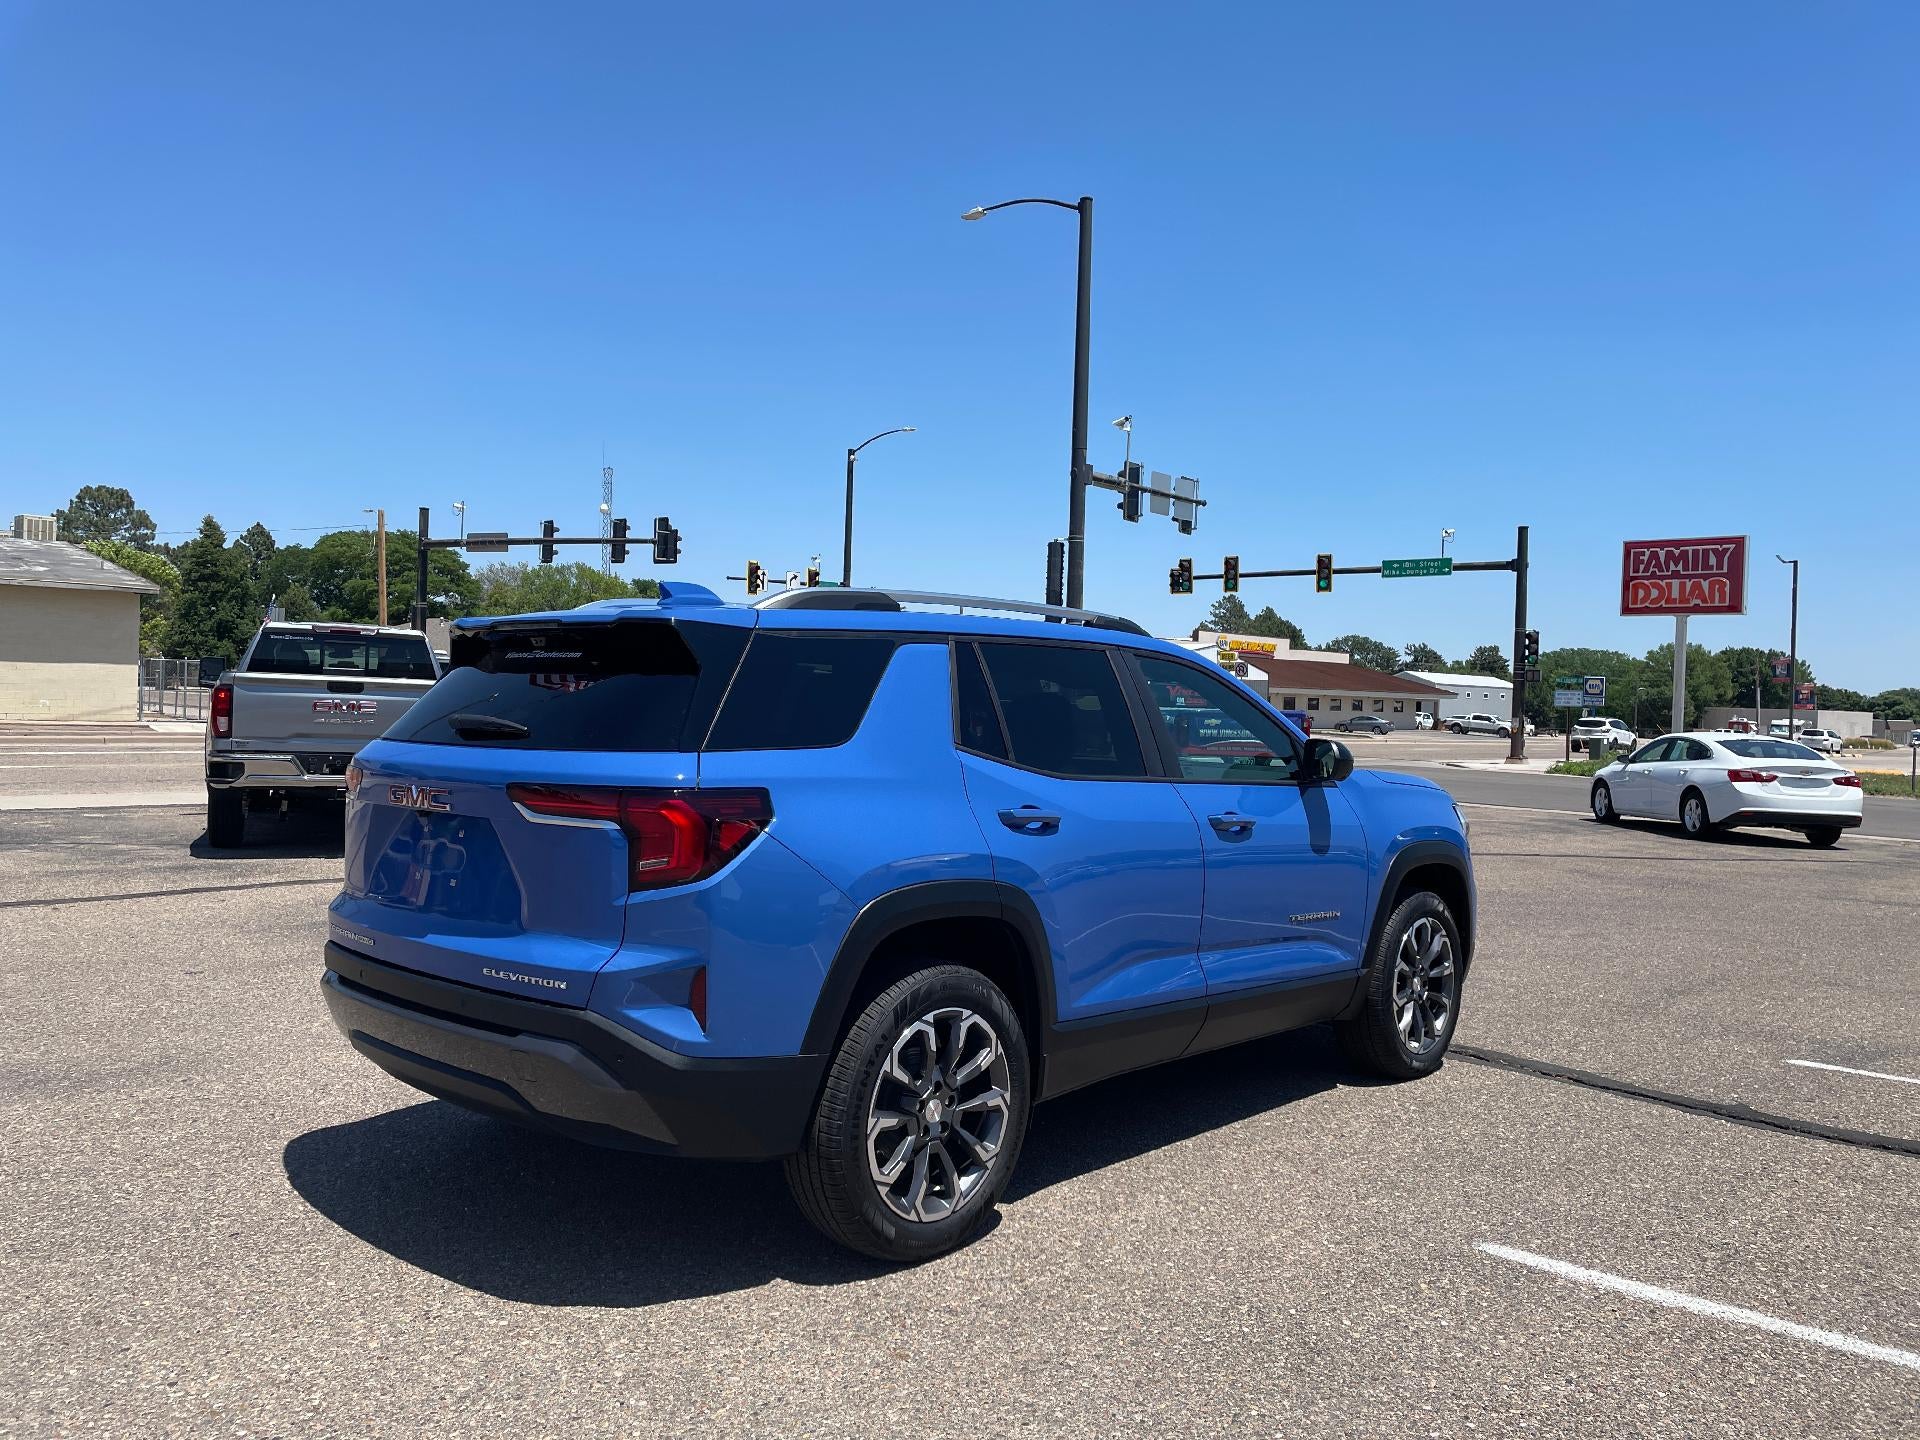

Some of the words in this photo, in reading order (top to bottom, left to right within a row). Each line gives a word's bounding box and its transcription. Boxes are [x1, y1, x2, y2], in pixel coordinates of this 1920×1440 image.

[1630, 544, 1736, 577] FAMILY
[1628, 577, 1730, 609] DOLLAR
[312, 699, 377, 714] GMC
[388, 784, 451, 811] GMC
[1289, 910, 1341, 921] TERRAIN
[482, 967, 567, 990] ELEVATION
